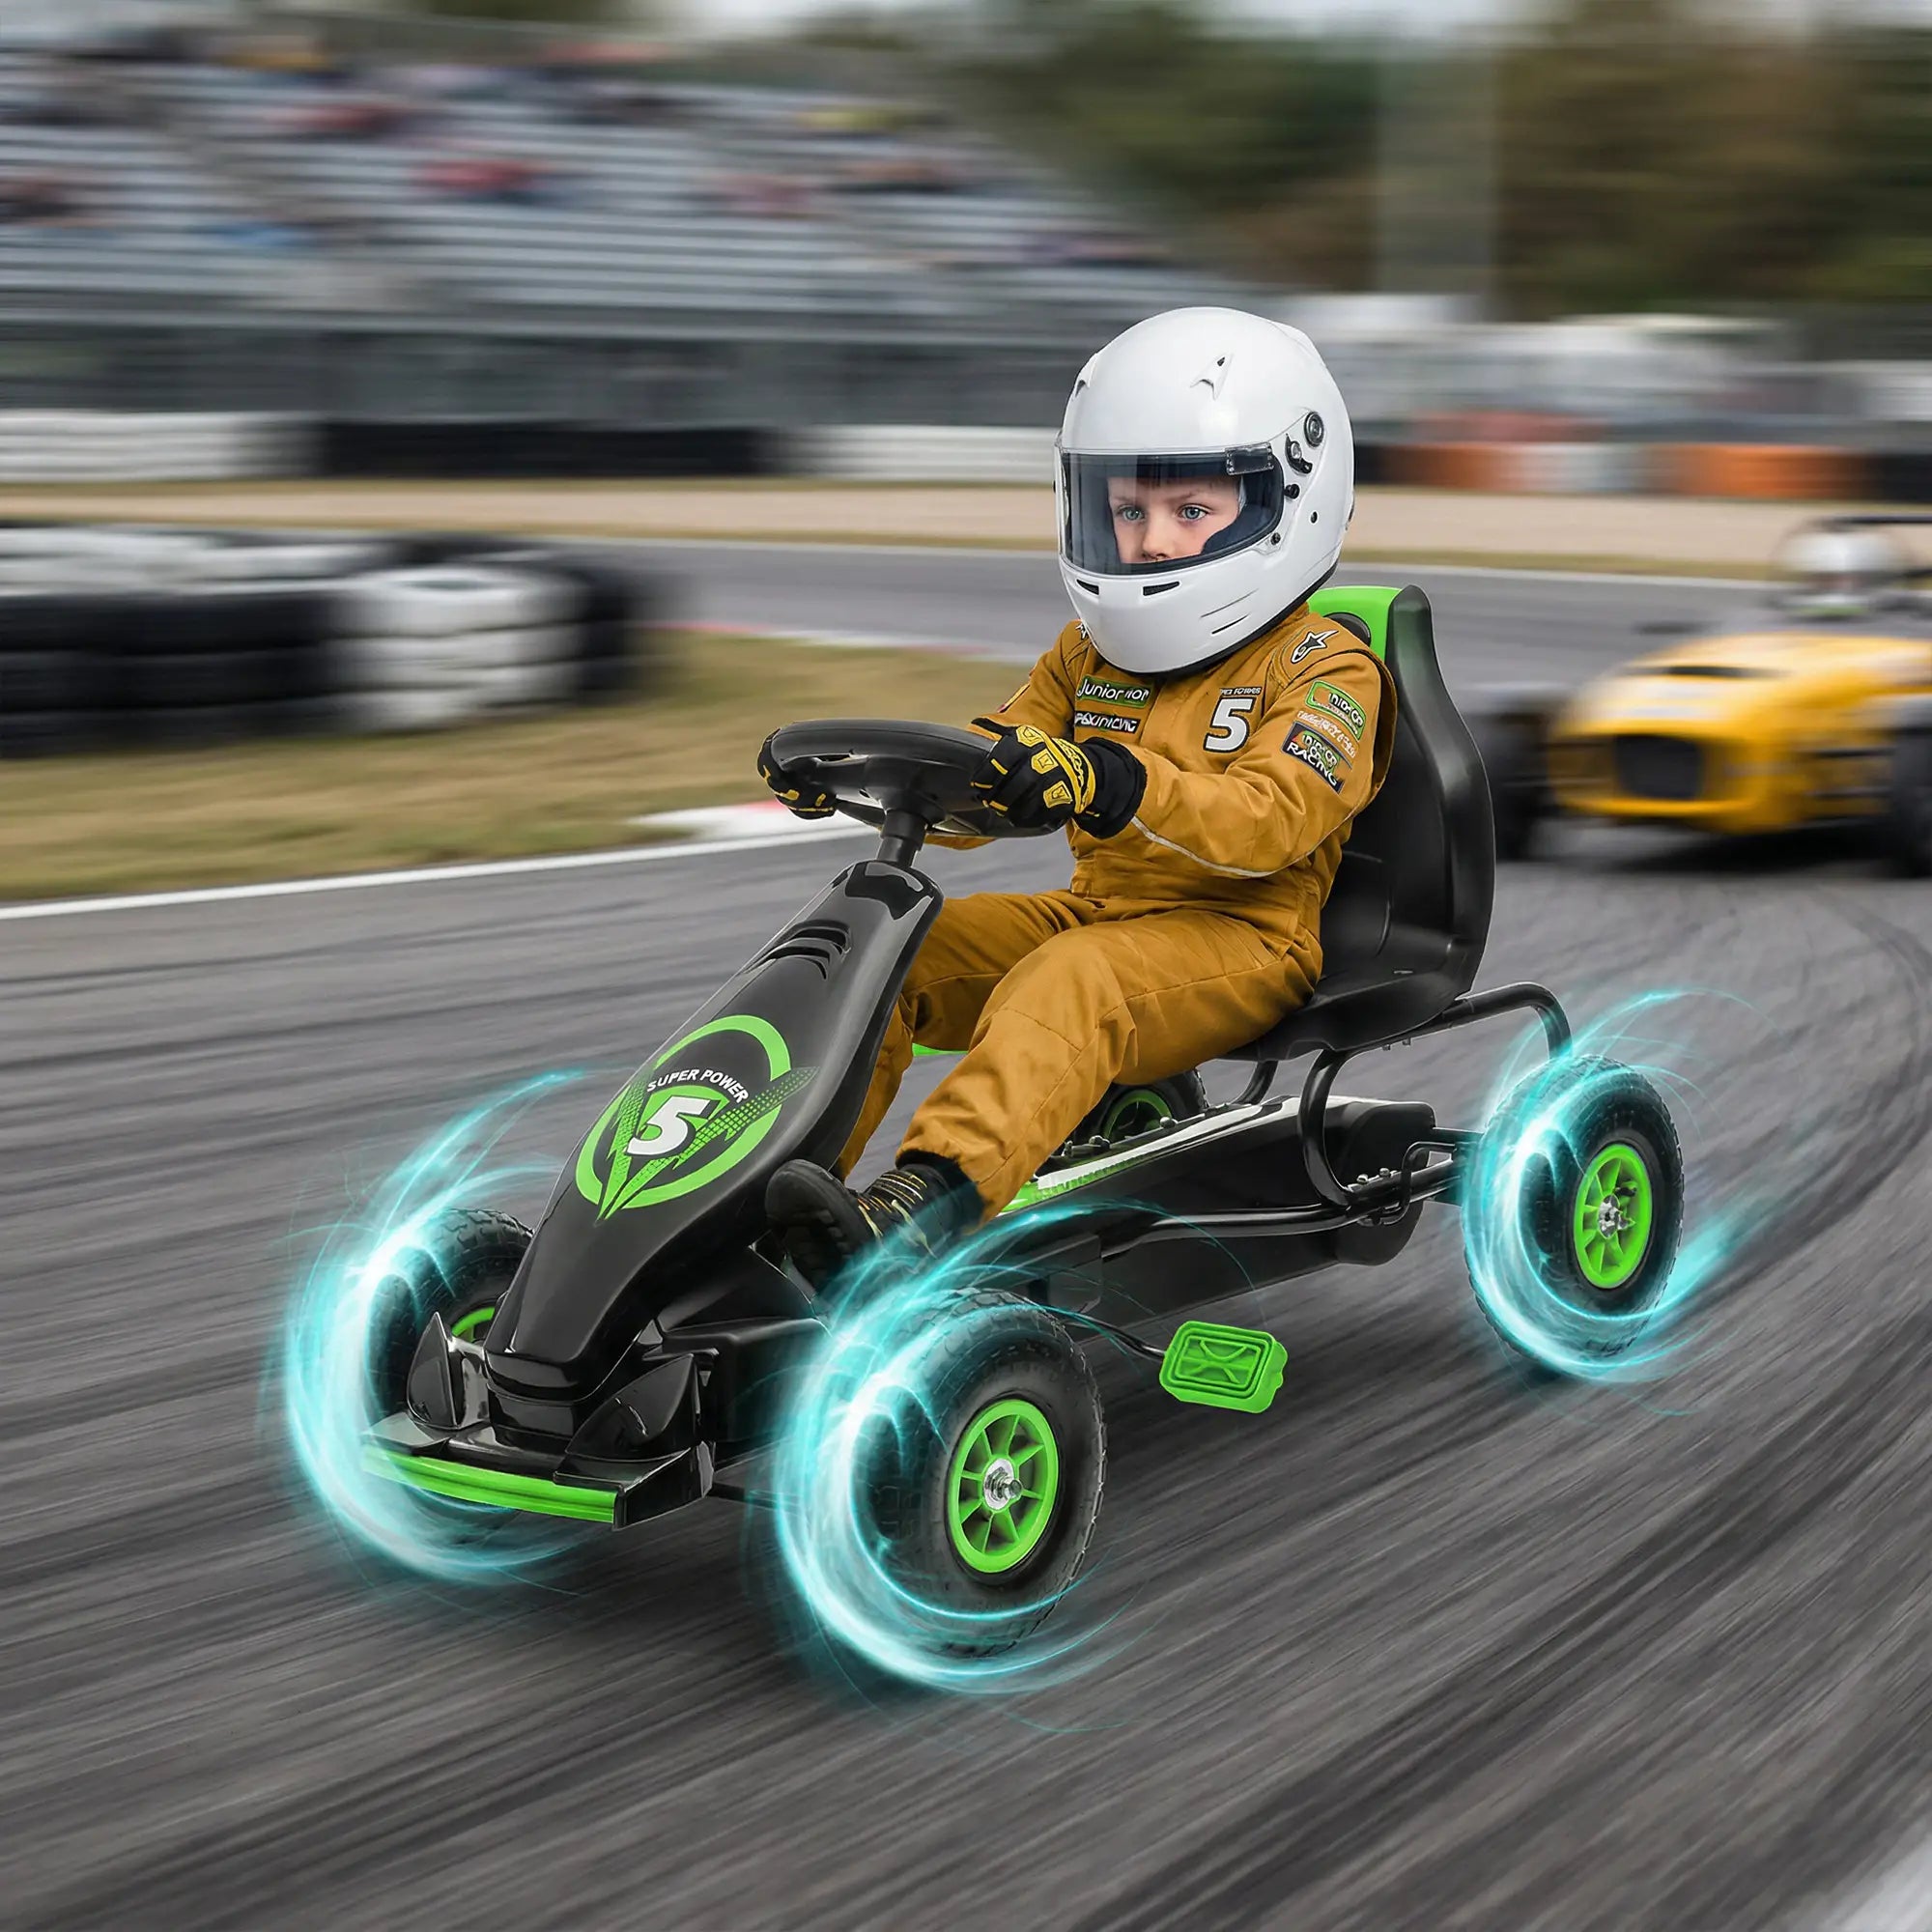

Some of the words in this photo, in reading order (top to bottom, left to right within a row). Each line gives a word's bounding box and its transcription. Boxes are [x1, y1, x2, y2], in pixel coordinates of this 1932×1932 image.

[1077, 678, 1124, 700] Junior
[1205, 696, 1255, 752] 5
[646, 1068, 699, 1093] SUPER
[700, 1068, 750, 1103] POWER
[626, 1095, 711, 1155] 5
